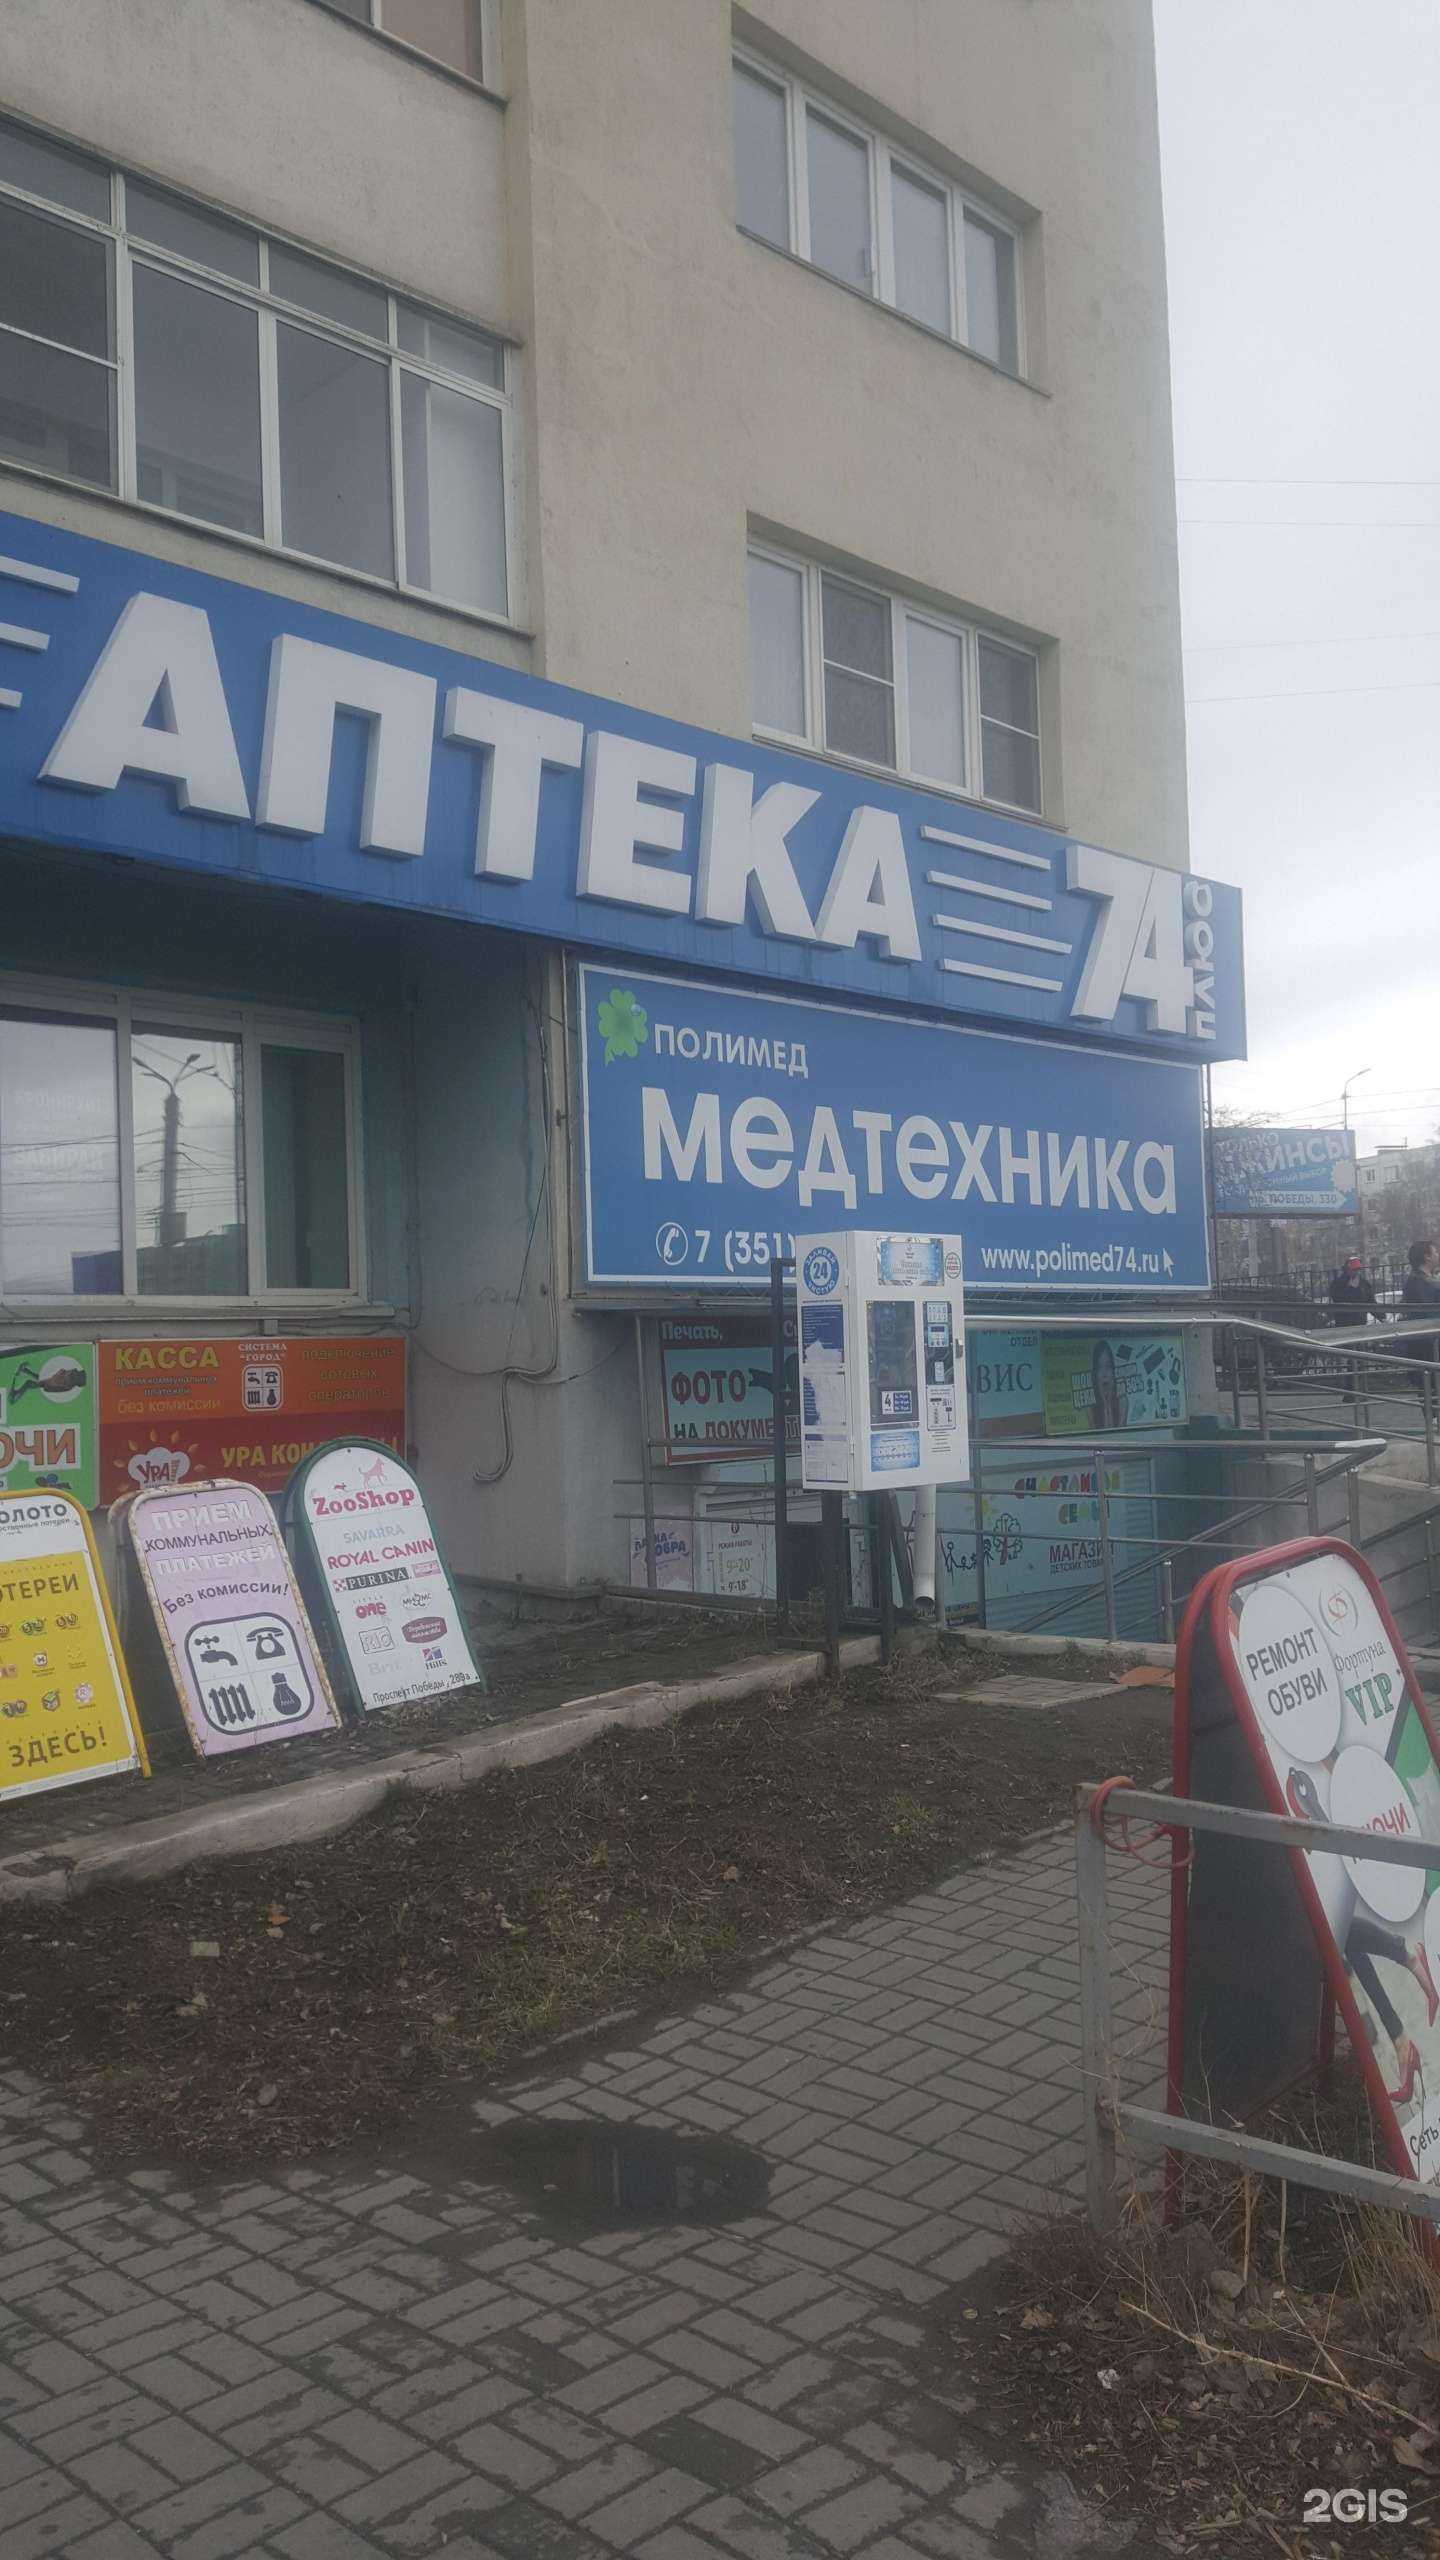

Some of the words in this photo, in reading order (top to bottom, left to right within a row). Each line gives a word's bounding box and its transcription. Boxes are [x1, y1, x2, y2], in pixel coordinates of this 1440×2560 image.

[36, 590, 922, 962] АПТЕКА
[1066, 845, 1193, 1034] 74
[1183, 880, 1216, 1040] ПЛЮС
[654, 1023, 808, 1078] ПОЛИМЕД
[694, 1230, 711, 1263] 7
[981, 1243, 1160, 1277] www.polimed74.ru
[813, 1261, 828, 1279] 24
[662, 1320, 723, 1340] Печать,
[115, 1346, 220, 1370] КАССА
[238, 1343, 287, 1351] СИСТЕМА
[671, 1368, 747, 1405] ФОТО
[977, 1362, 1033, 1394] ВИС
[221, 1445, 266, 1468] УРА
[150, 1500, 252, 1531] ПРИЕМ
[312, 1488, 415, 1515] ZooShop
[146, 1524, 271, 1551] КОММУНАЛЬНЫХ
[343, 1524, 405, 1543] SAVARRA
[327, 1550, 379, 1570] ROYAL
[381, 1538, 435, 1559] CANIN
[0, 1573, 79, 1603] ТЕРЕИ
[347, 1568, 408, 1590] PURINA
[163, 1593, 194, 1614] Без
[197, 1582, 289, 1600] комиссии!
[1246, 1628, 1319, 1681] РЕМОНТ
[1334, 1639, 1387, 1678] Фортуна
[1268, 1667, 1329, 1716] ОБУВИ
[1345, 1672, 1395, 1726] VIP
[9, 1726, 107, 1768] ЗДЕСЬ!
[1410, 2126, 1439, 2156] Сеть
